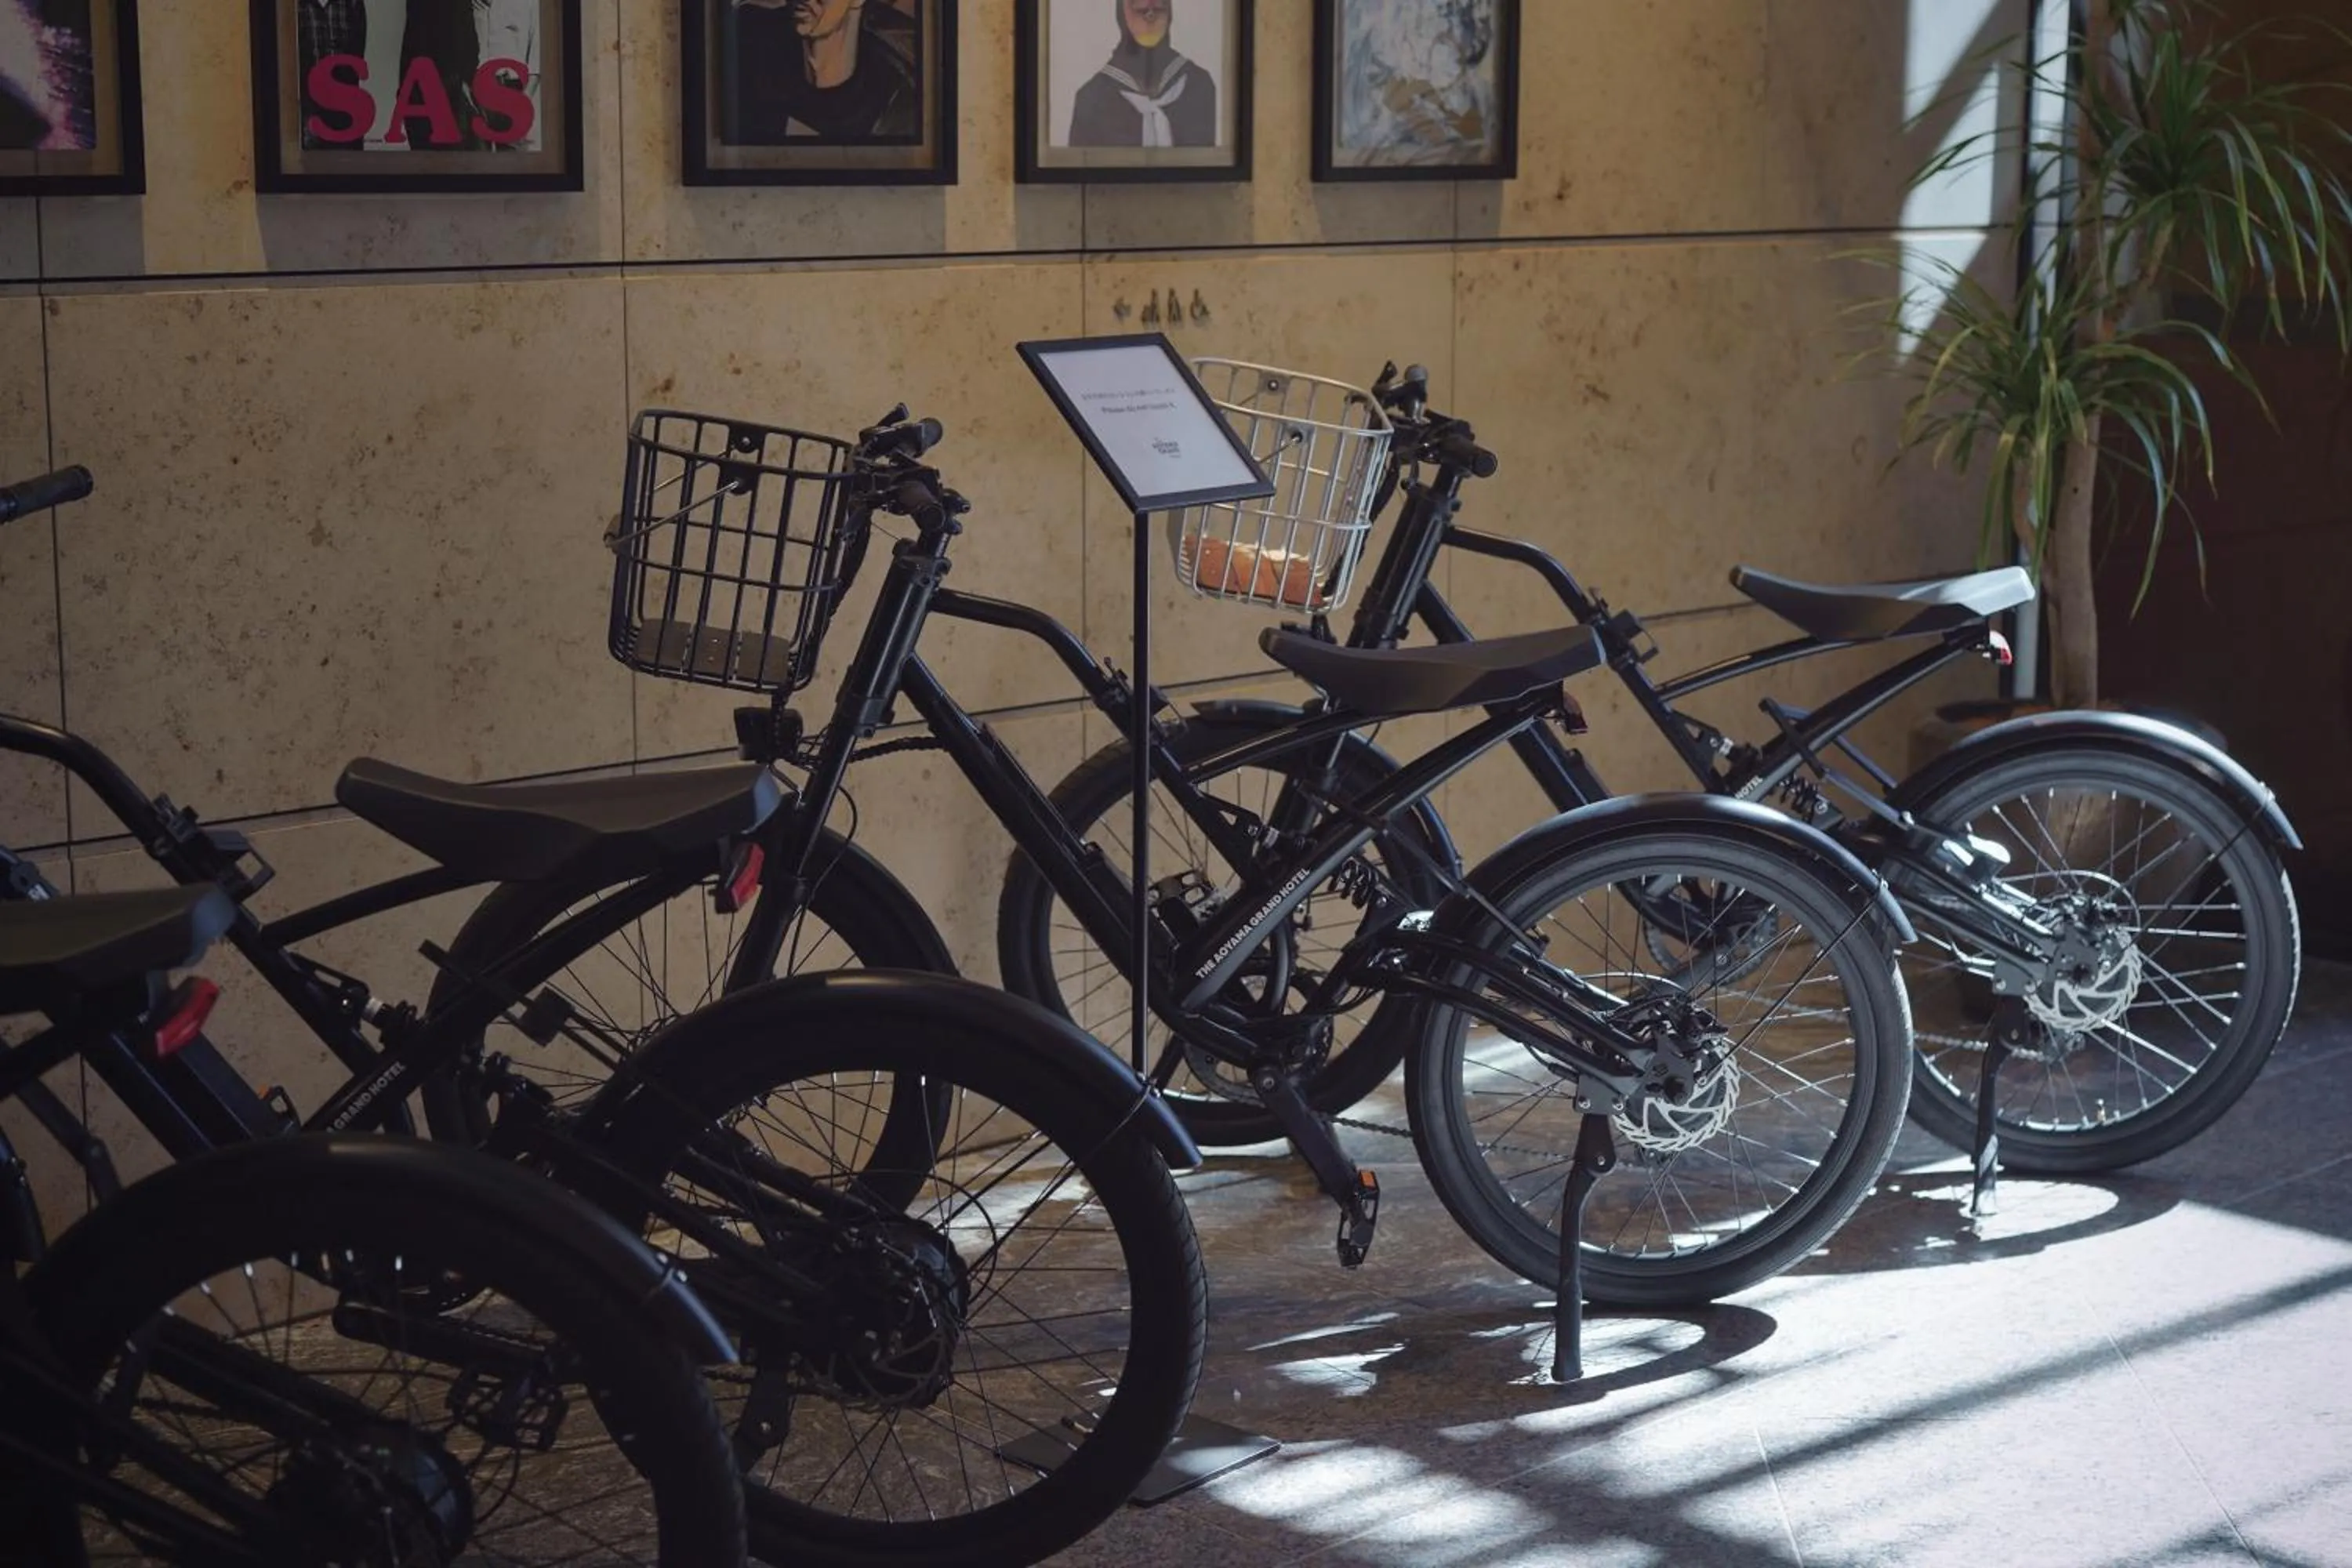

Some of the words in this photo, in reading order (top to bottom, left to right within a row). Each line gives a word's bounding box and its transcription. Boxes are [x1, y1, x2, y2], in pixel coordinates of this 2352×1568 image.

[307, 53, 535, 143] SAS
[1733, 775, 1763, 800] HOTEL
[1195, 958, 1216, 979] THE
[1213, 924, 1253, 964] AOYAMA
[1249, 892, 1283, 927] GRAND
[1279, 867, 1311, 898] HOTEL
[333, 1091, 372, 1130] GRAND
[368, 1061, 406, 1096] HOTEL
